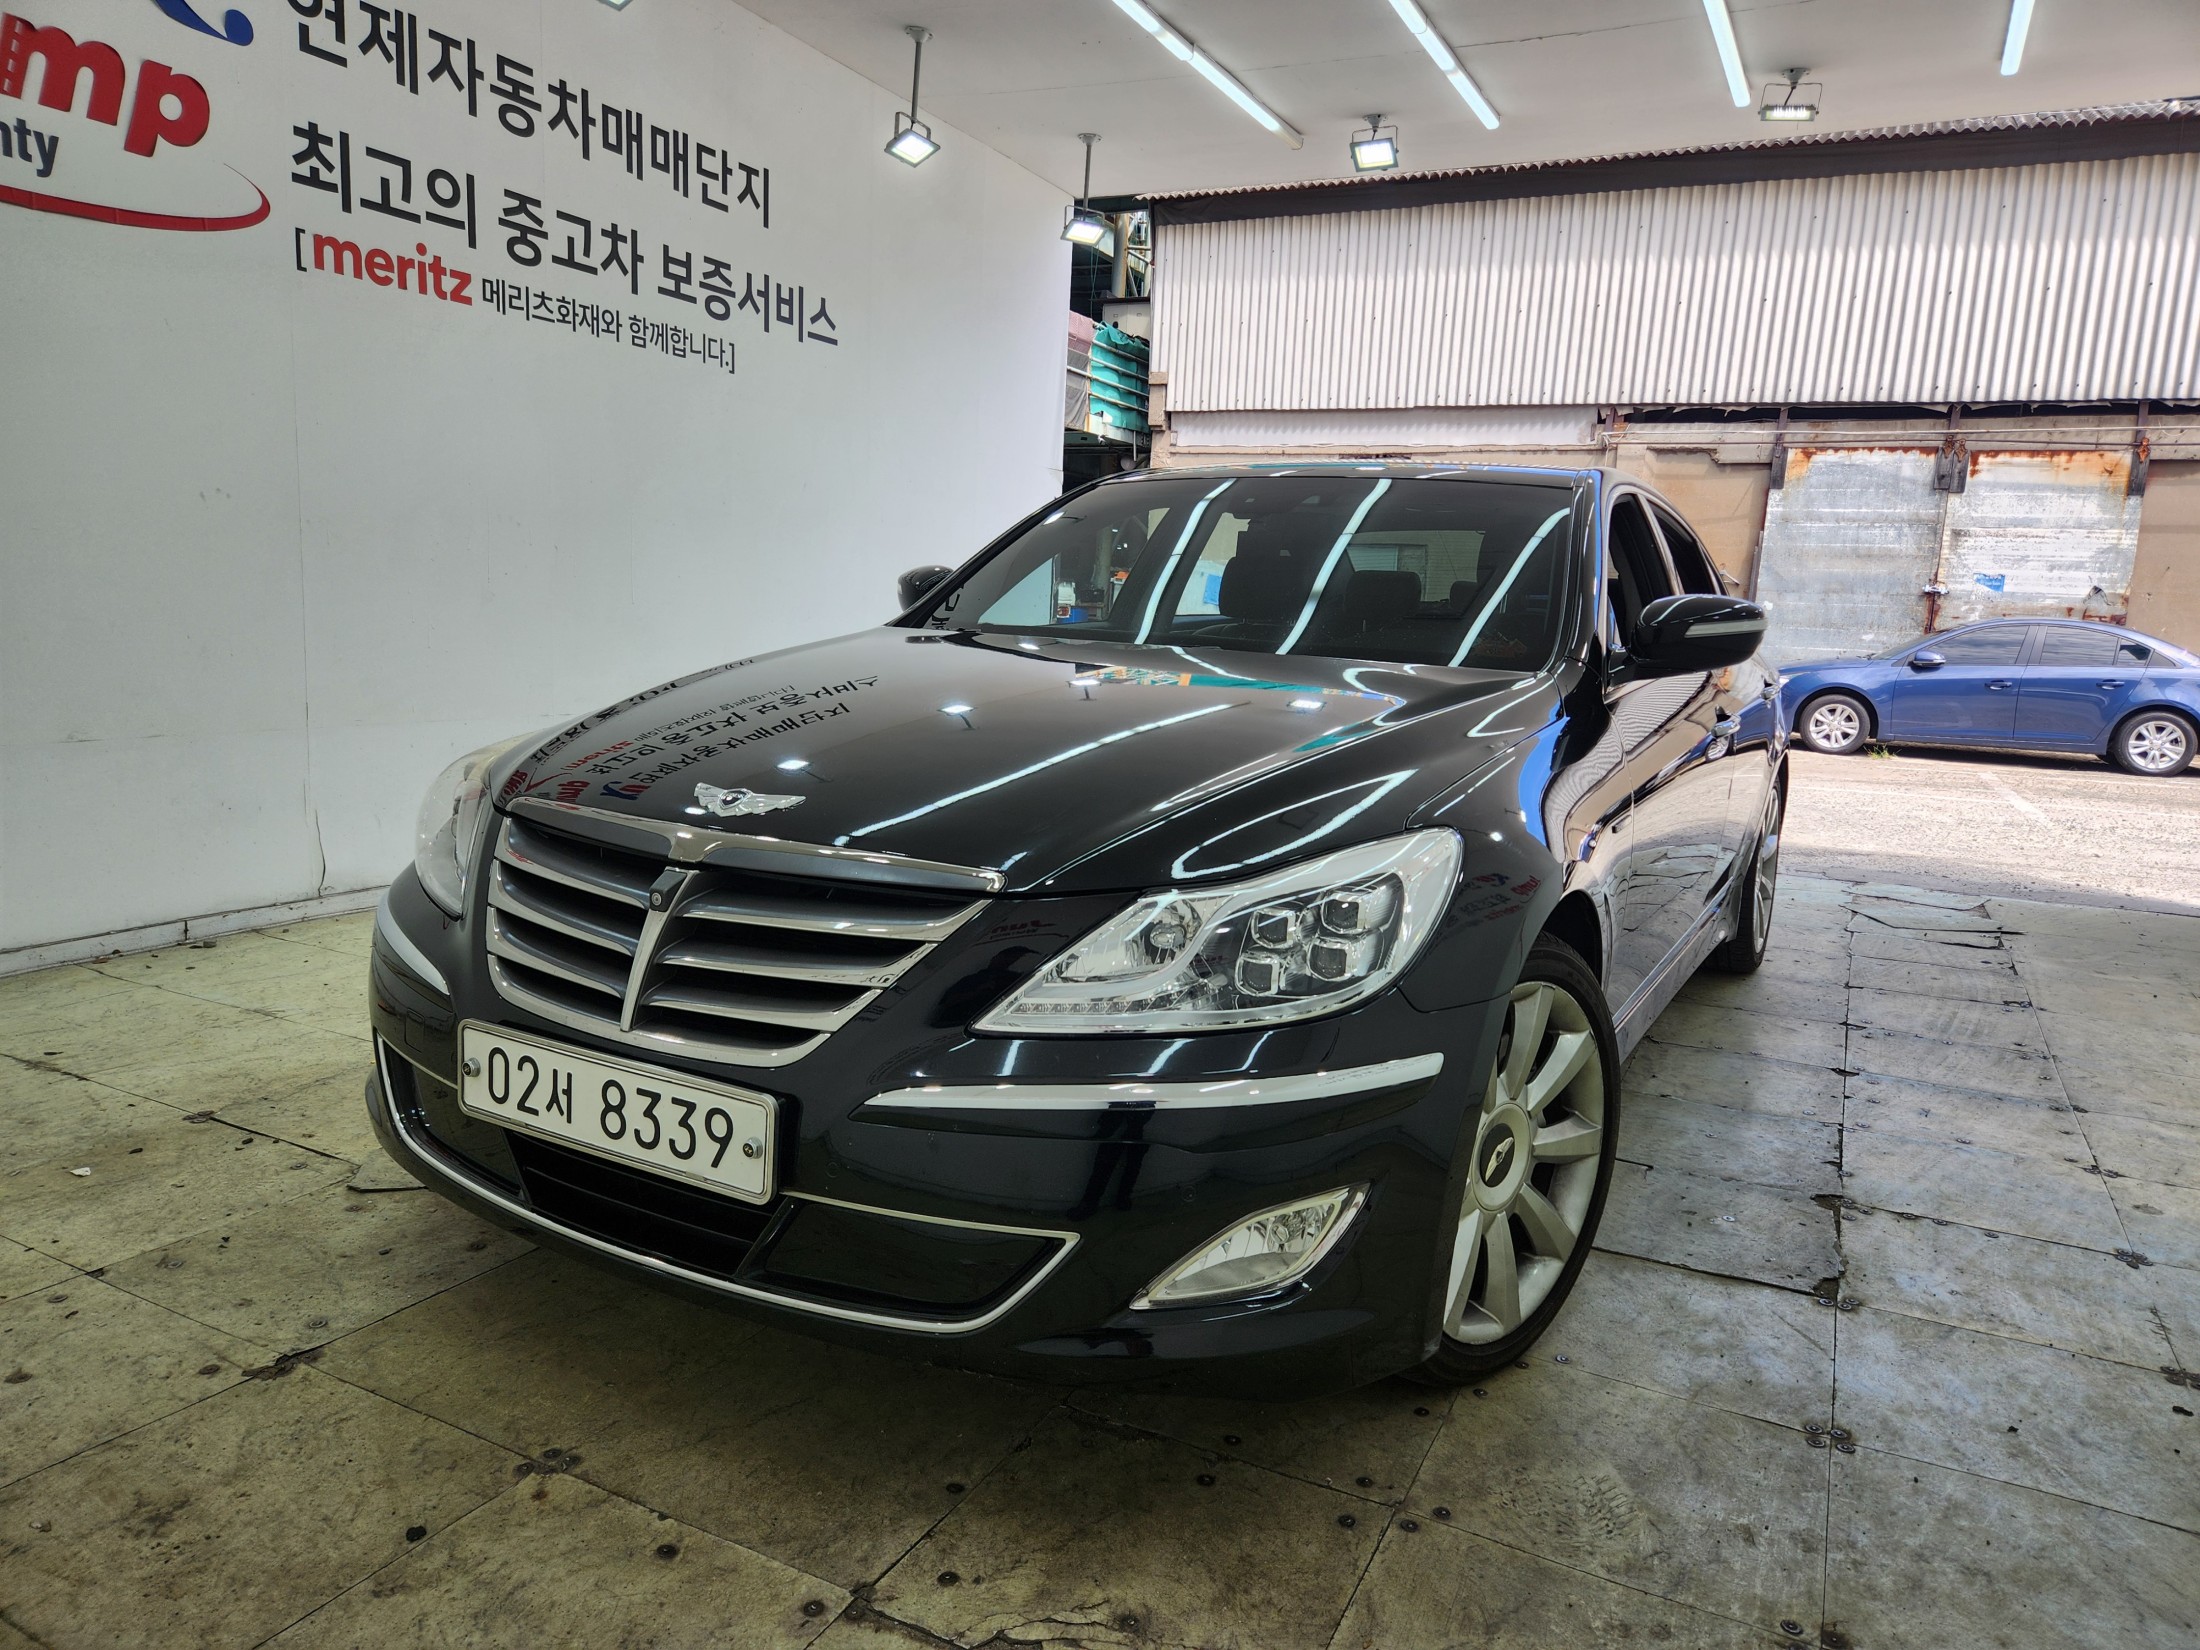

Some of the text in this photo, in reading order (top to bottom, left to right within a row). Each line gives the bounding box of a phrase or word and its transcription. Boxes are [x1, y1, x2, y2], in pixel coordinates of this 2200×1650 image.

[291, 121, 838, 346] 최고의 중고차 보증서비스
[482, 278, 623, 342] 메리츠화재와
[488, 1047, 734, 1169] 02서 8339
